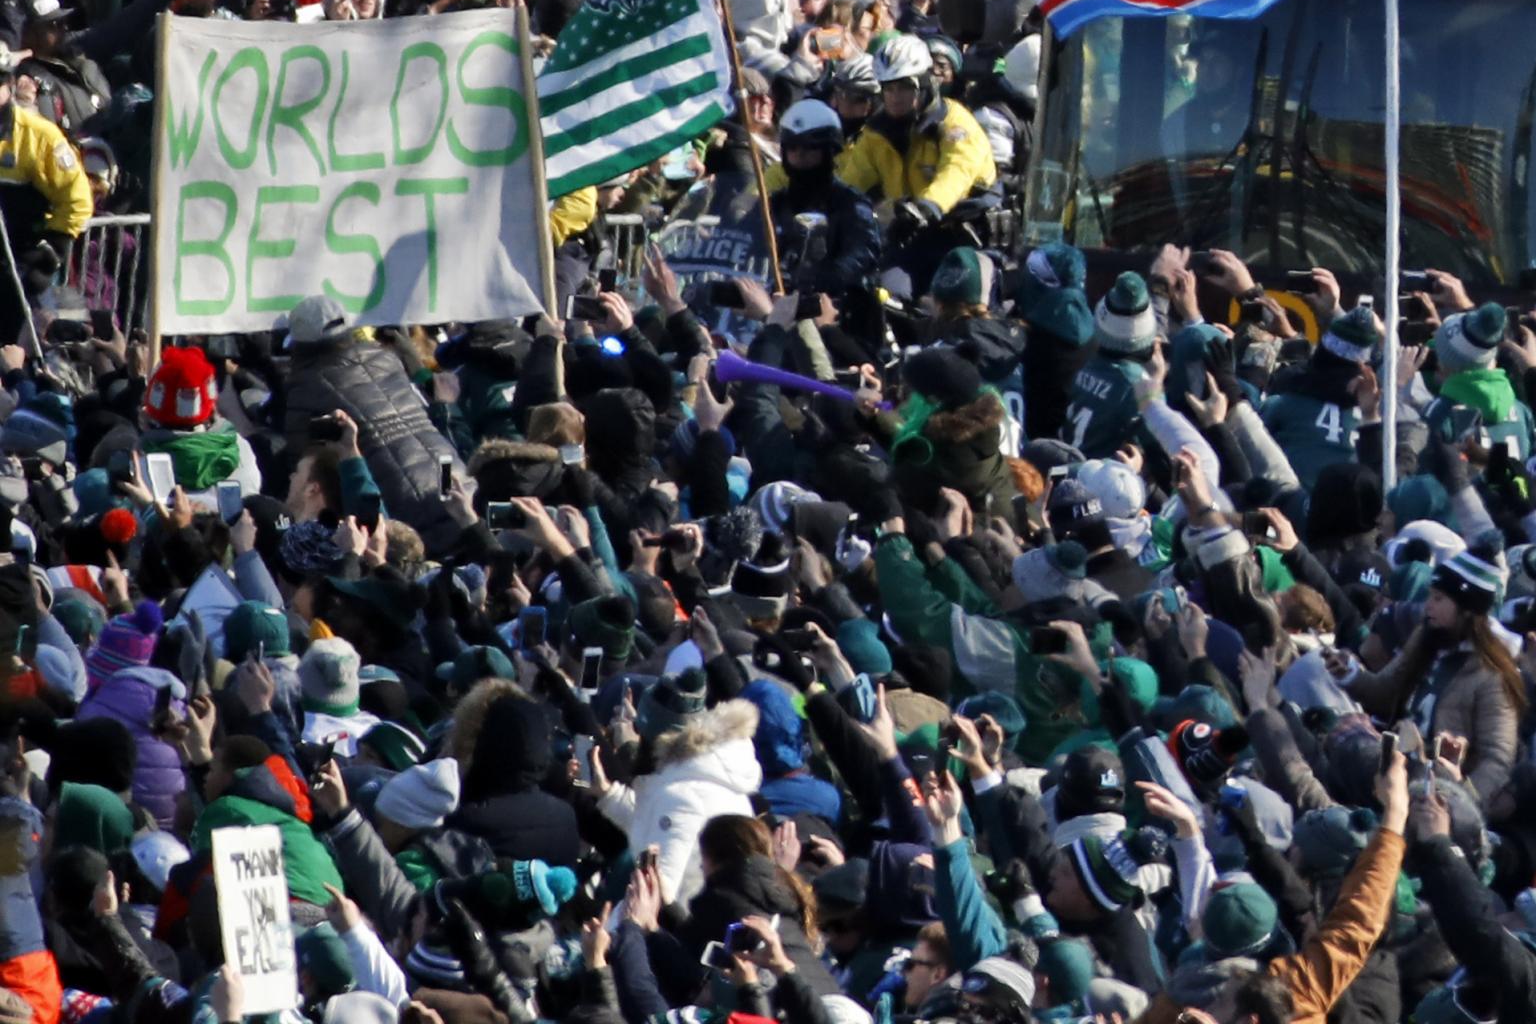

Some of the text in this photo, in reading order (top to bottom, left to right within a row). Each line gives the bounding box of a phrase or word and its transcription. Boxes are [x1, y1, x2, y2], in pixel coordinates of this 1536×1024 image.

[166, 31, 530, 176] WORLDS
[174, 176, 469, 316] BEST
[1315, 402, 1361, 448] 4
